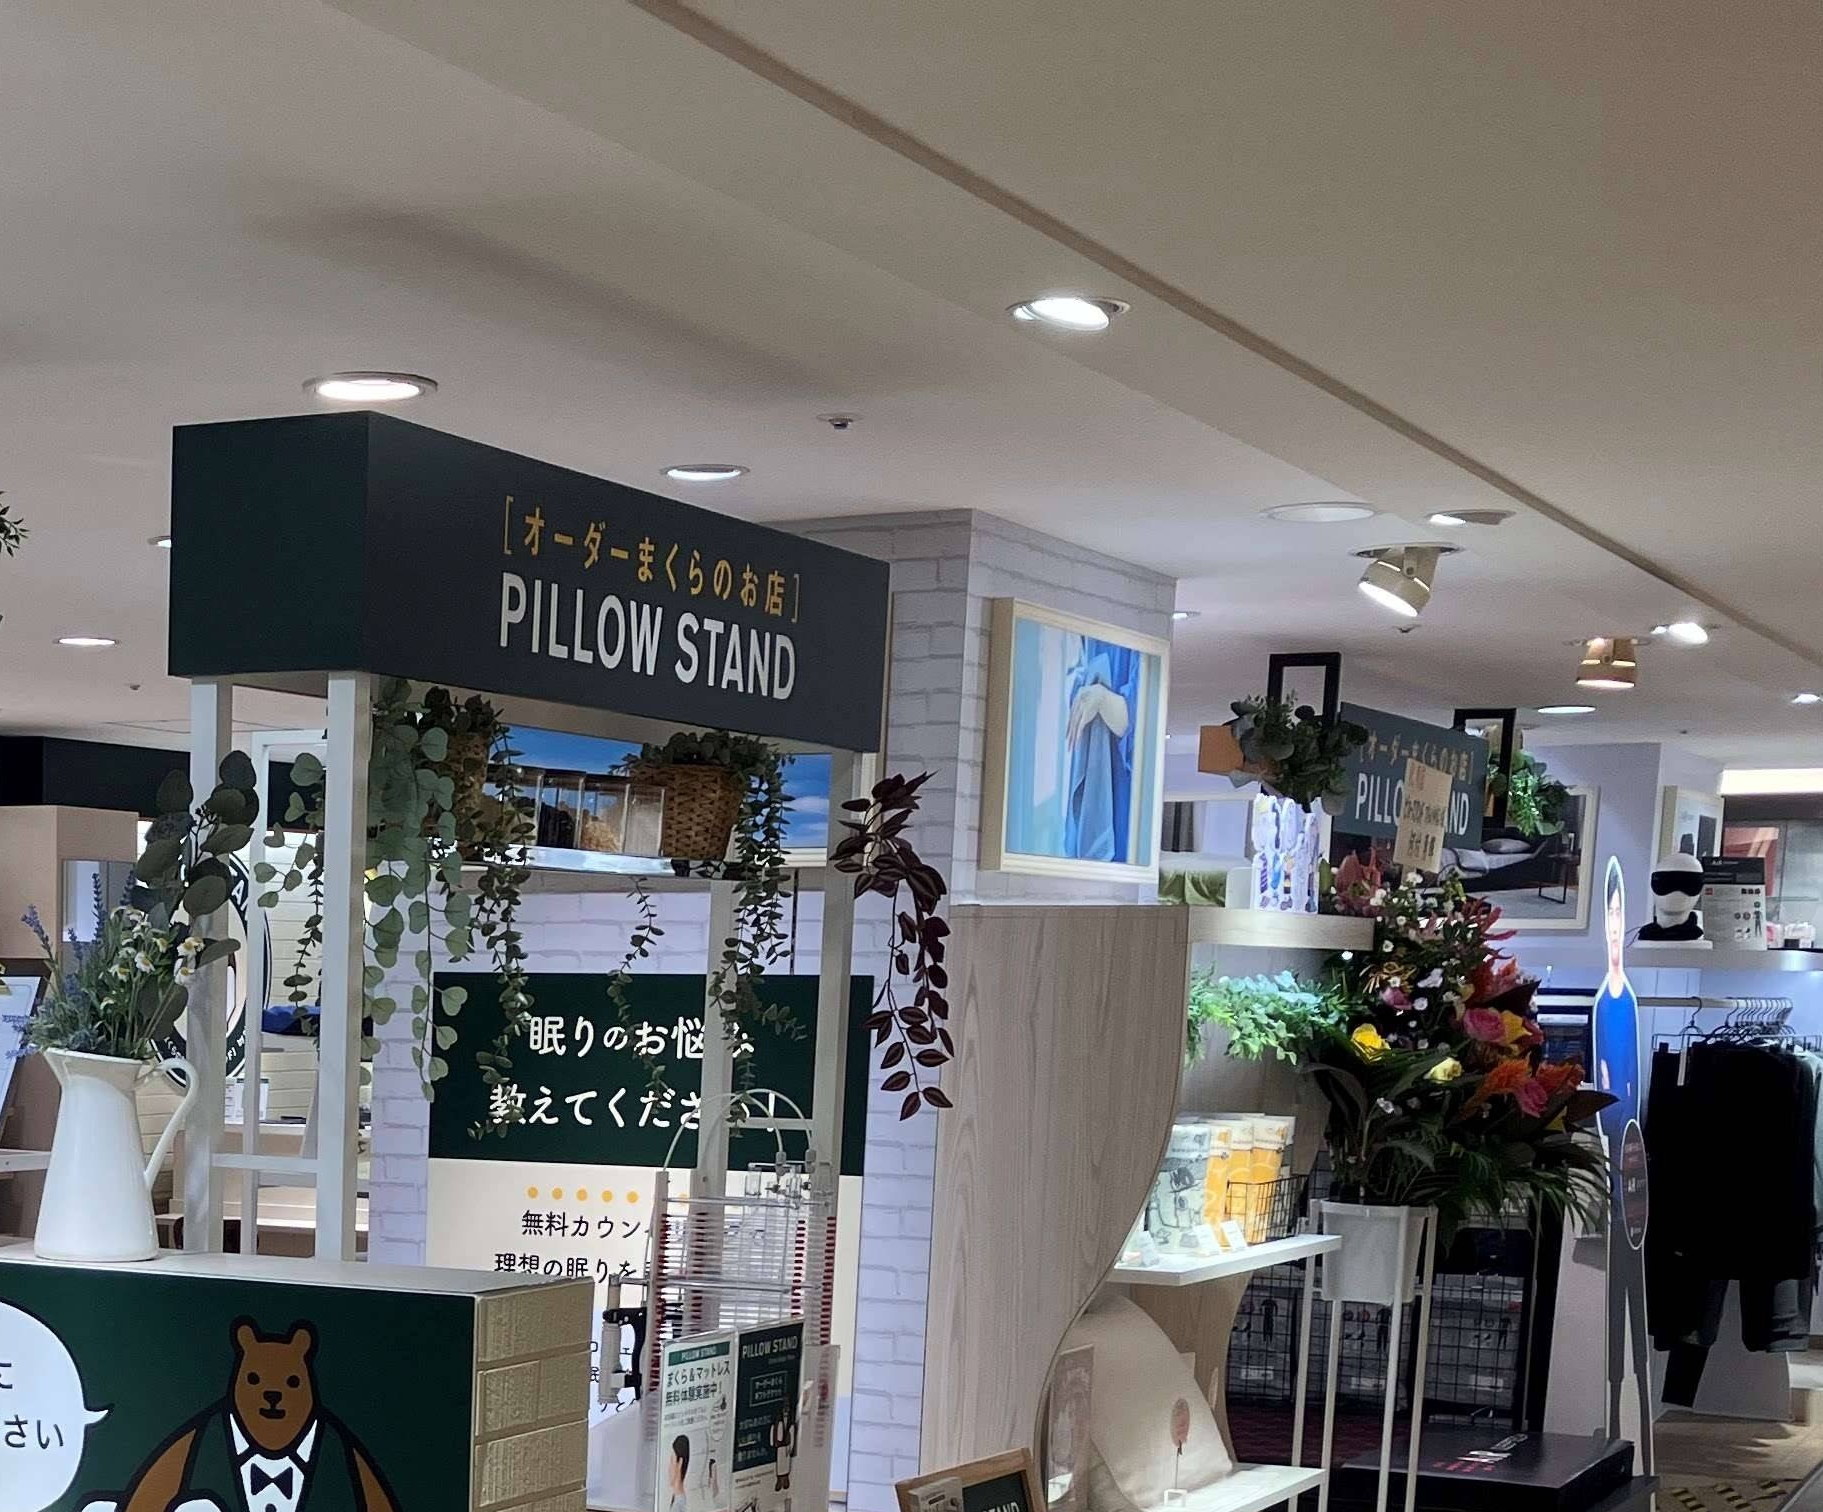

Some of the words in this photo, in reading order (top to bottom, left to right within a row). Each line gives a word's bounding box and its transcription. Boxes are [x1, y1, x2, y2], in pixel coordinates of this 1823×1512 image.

[500, 573, 664, 677] PILLOW
[676, 612, 796, 699] STAND
[1355, 773, 1405, 826] PILLO
[742, 1341, 772, 1359] PILLOW
[772, 1335, 799, 1353] STAND
